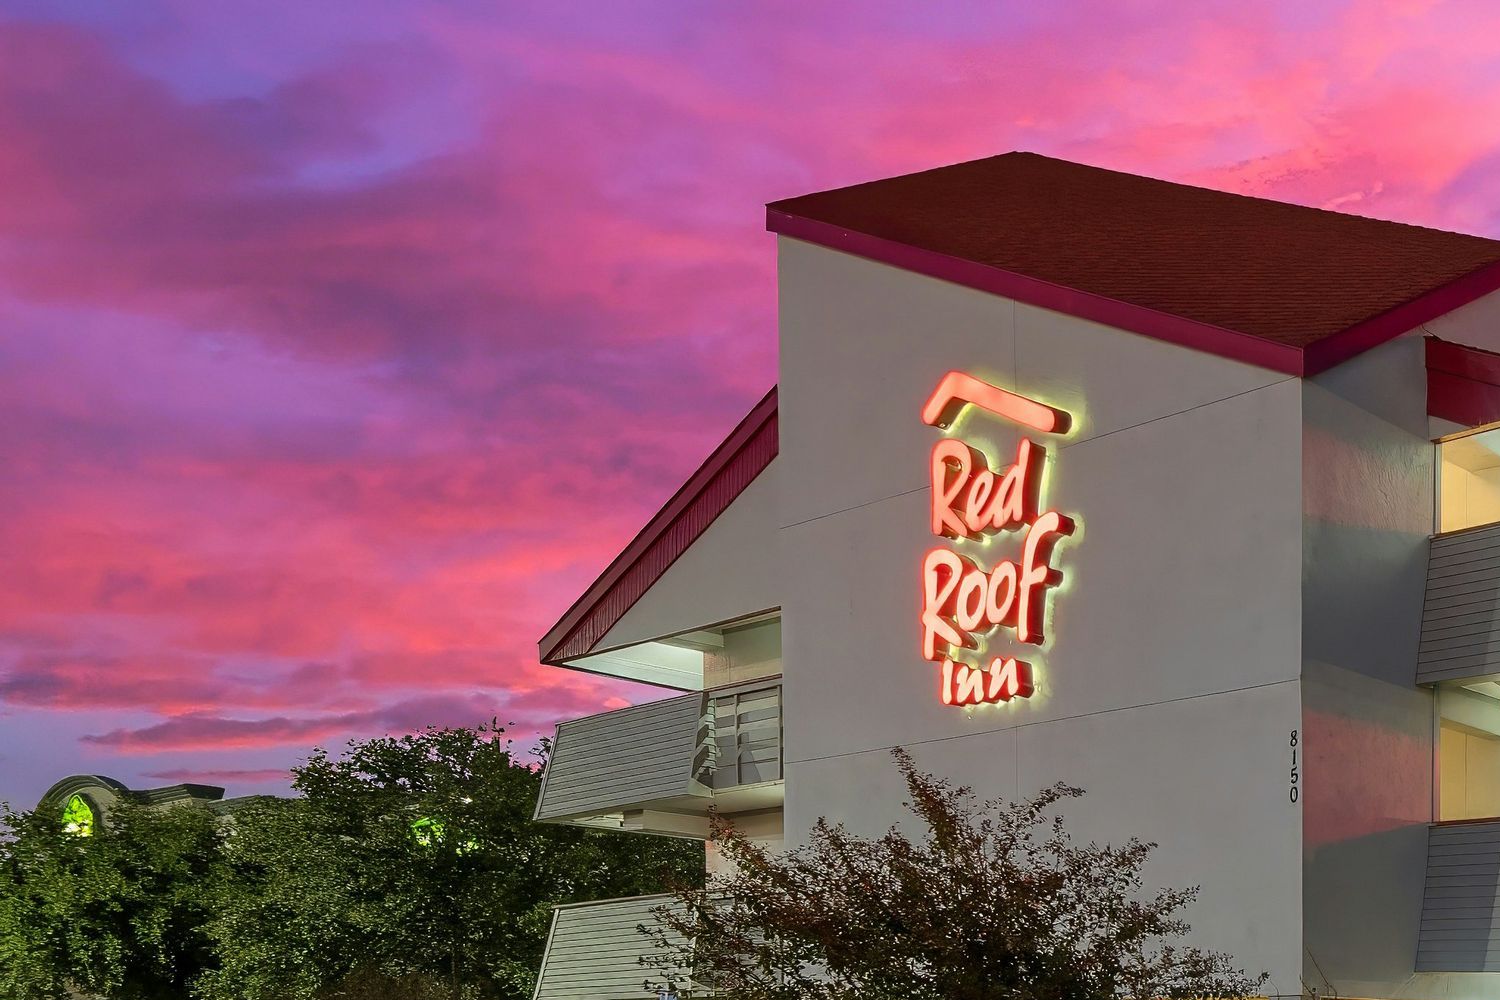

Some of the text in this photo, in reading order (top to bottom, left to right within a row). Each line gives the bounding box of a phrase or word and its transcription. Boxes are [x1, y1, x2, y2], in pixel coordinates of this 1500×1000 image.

[930, 437, 1034, 538] Red
[921, 511, 1062, 661] Roof
[1289, 729, 1299, 803] 8150
